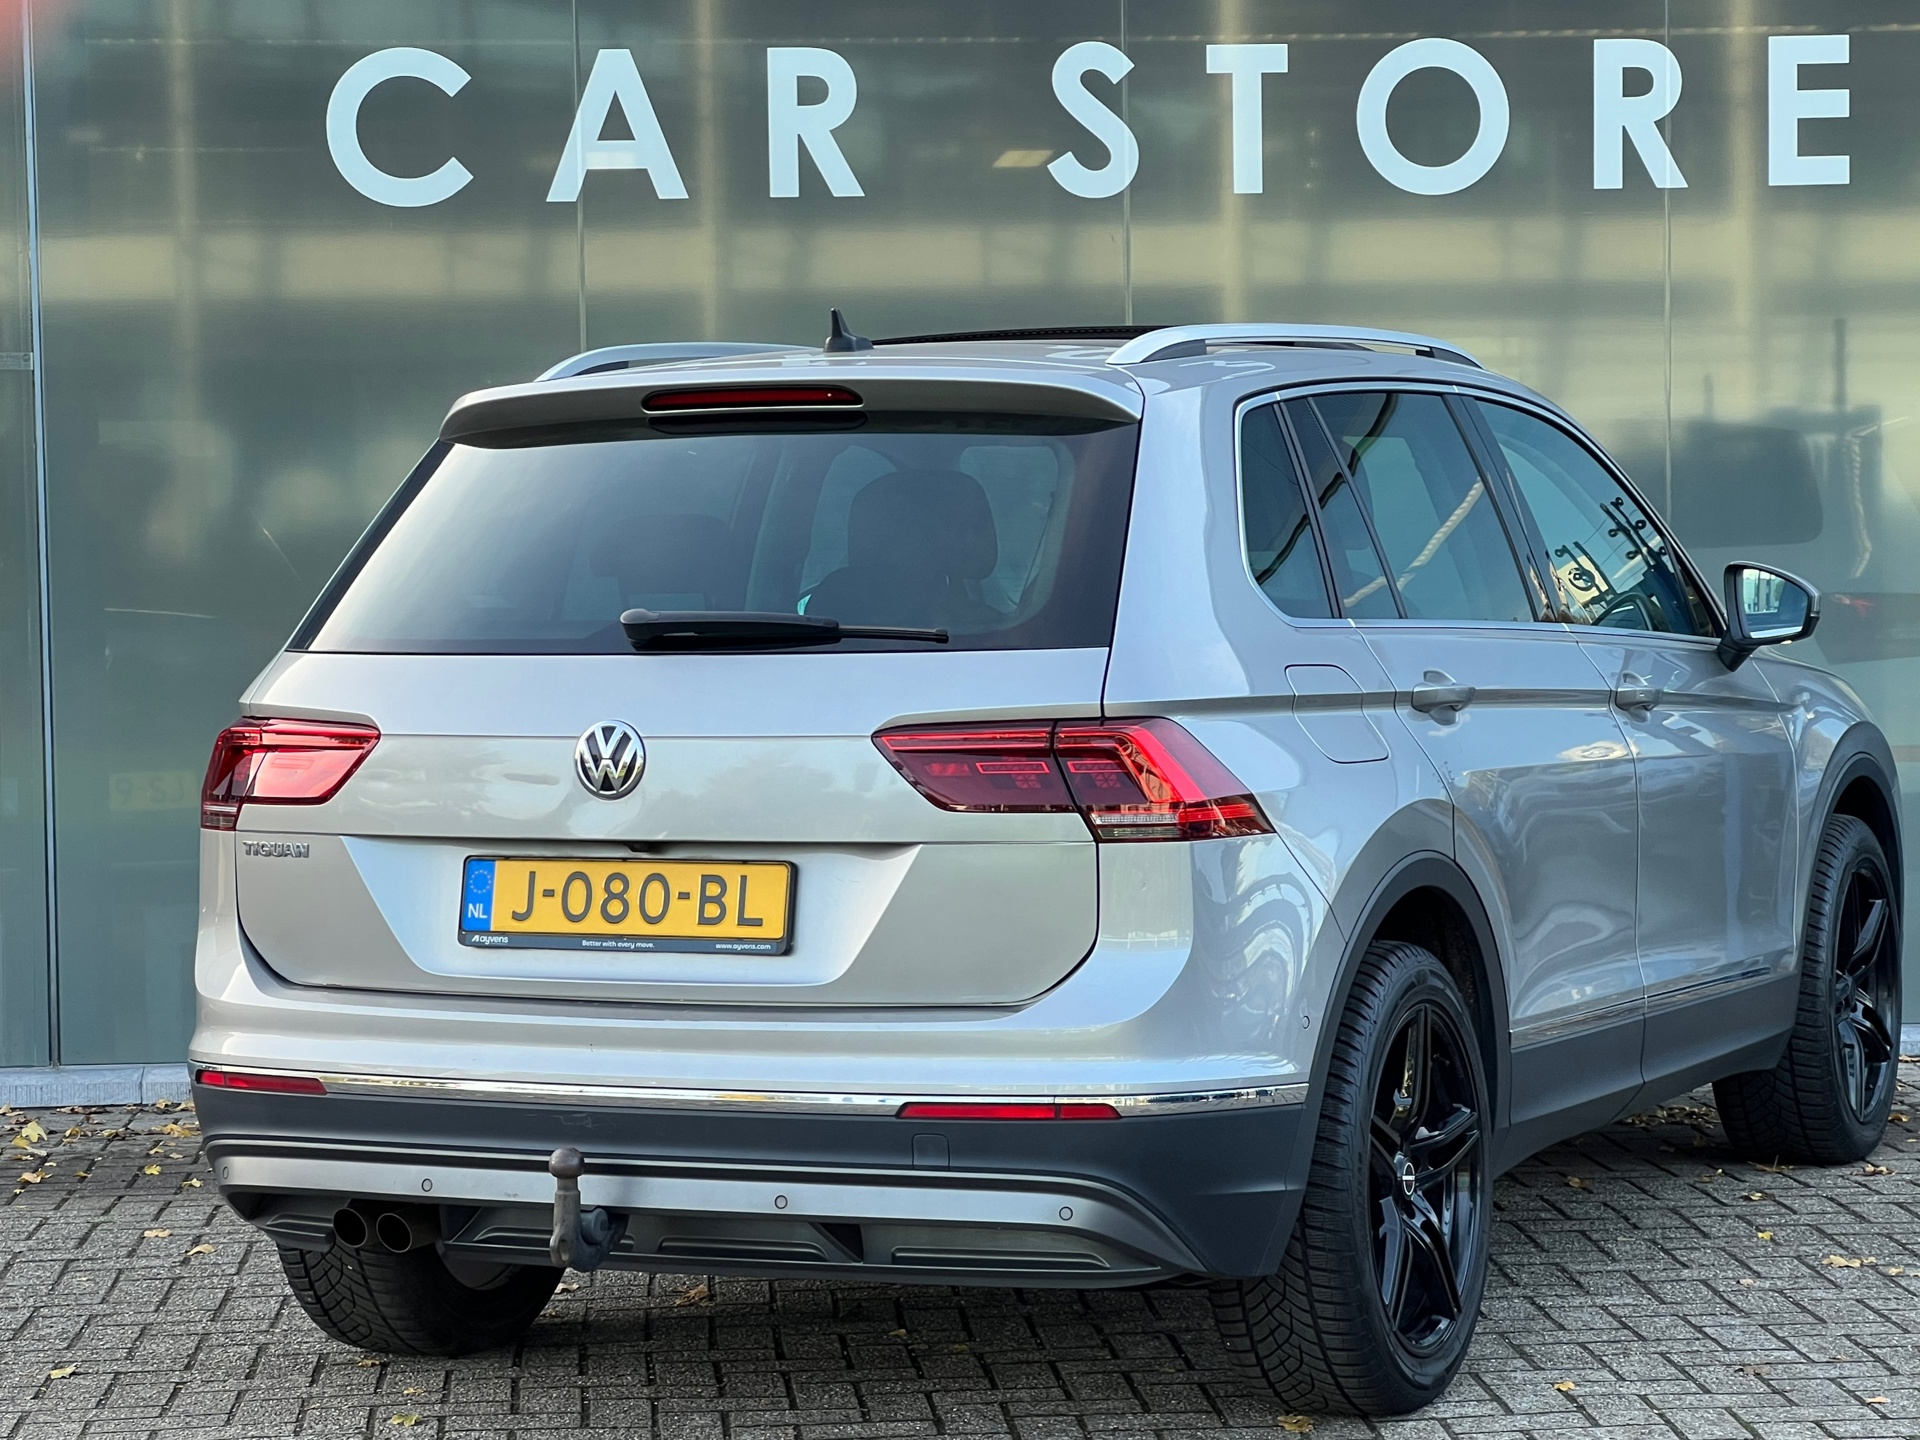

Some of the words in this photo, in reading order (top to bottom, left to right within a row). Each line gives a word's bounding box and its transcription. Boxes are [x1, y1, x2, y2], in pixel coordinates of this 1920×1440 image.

[326, 47, 865, 207] CAR
[1047, 34, 1851, 198] STORE
[242, 840, 310, 859] TIGUAN
[468, 903, 488, 919] NL
[511, 870, 764, 928] J-080-BL
